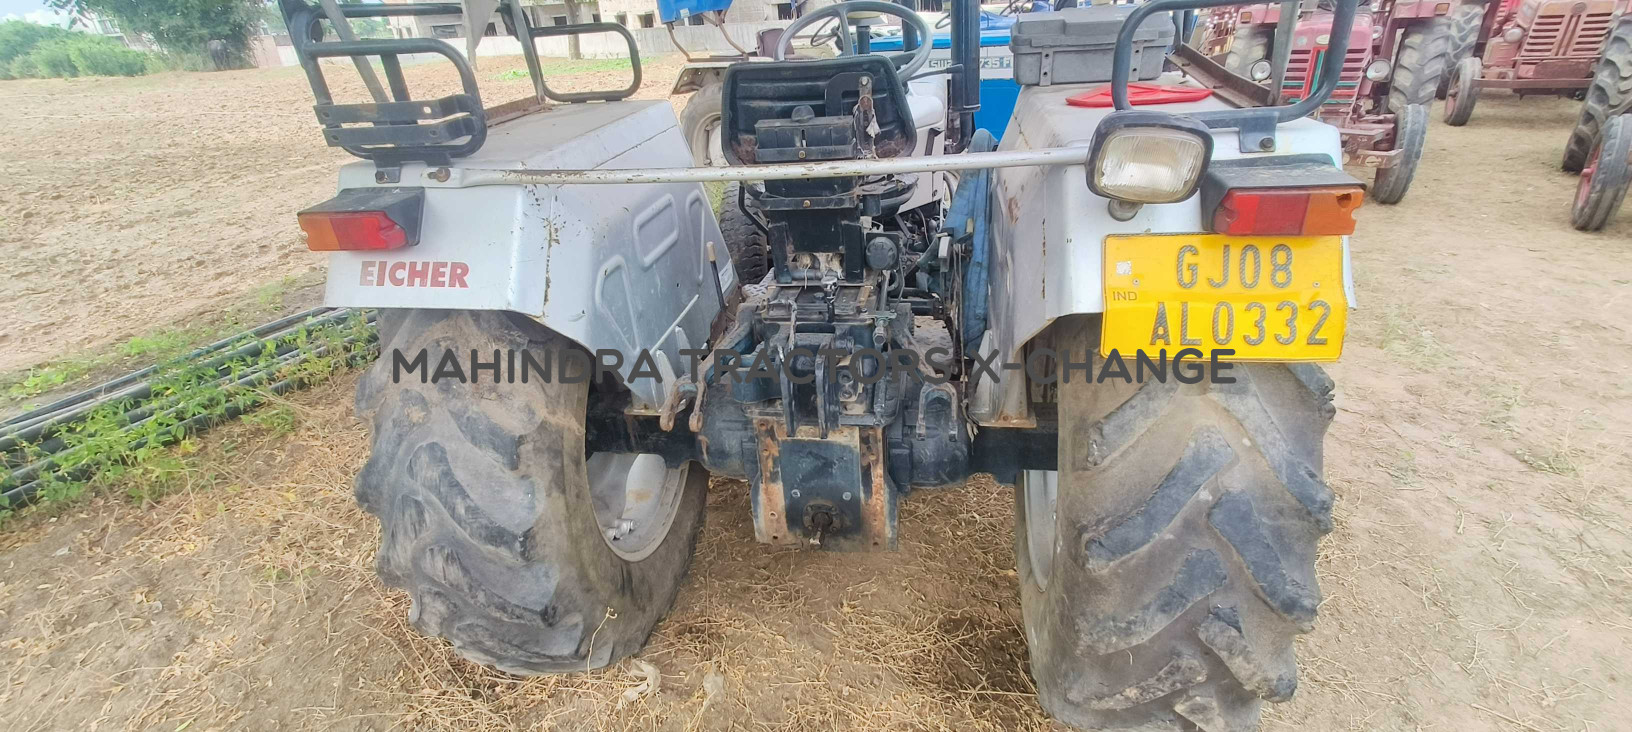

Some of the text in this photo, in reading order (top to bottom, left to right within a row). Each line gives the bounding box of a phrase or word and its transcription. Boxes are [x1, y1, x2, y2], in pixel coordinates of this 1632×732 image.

[360, 261, 469, 288] EICHER
[1177, 244, 1293, 289] GJ08
[1112, 290, 1138, 301] IND
[1149, 300, 1332, 346] AL0332
